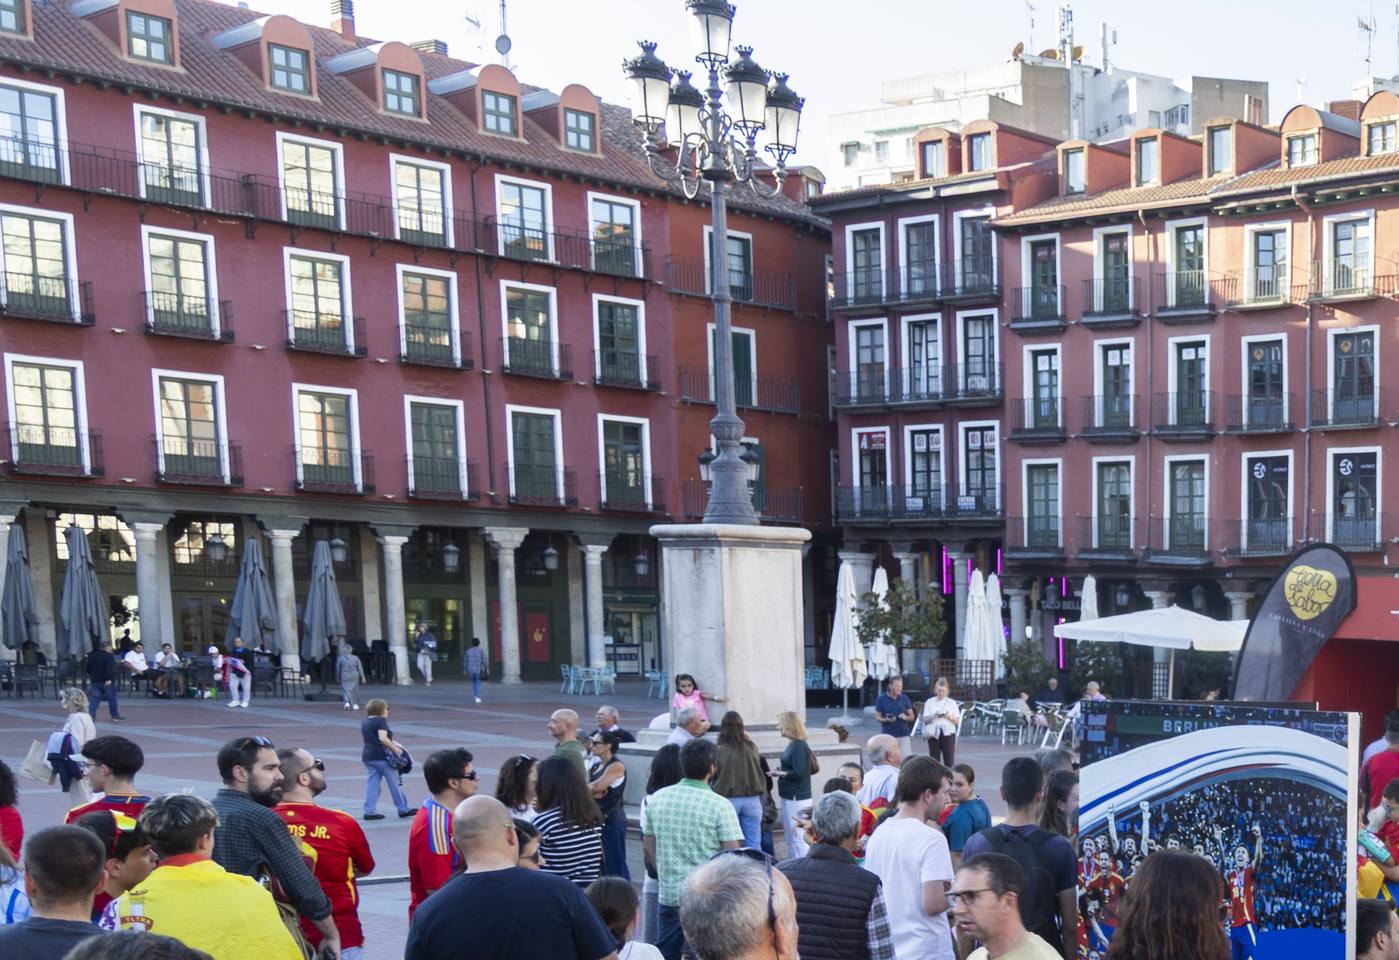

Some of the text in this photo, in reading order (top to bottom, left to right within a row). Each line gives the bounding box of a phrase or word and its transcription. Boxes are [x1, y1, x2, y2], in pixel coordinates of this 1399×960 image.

[1041, 600, 1061, 609] TACO
[1163, 719, 1220, 735] BERLIN
[310, 824, 331, 840] JR.
